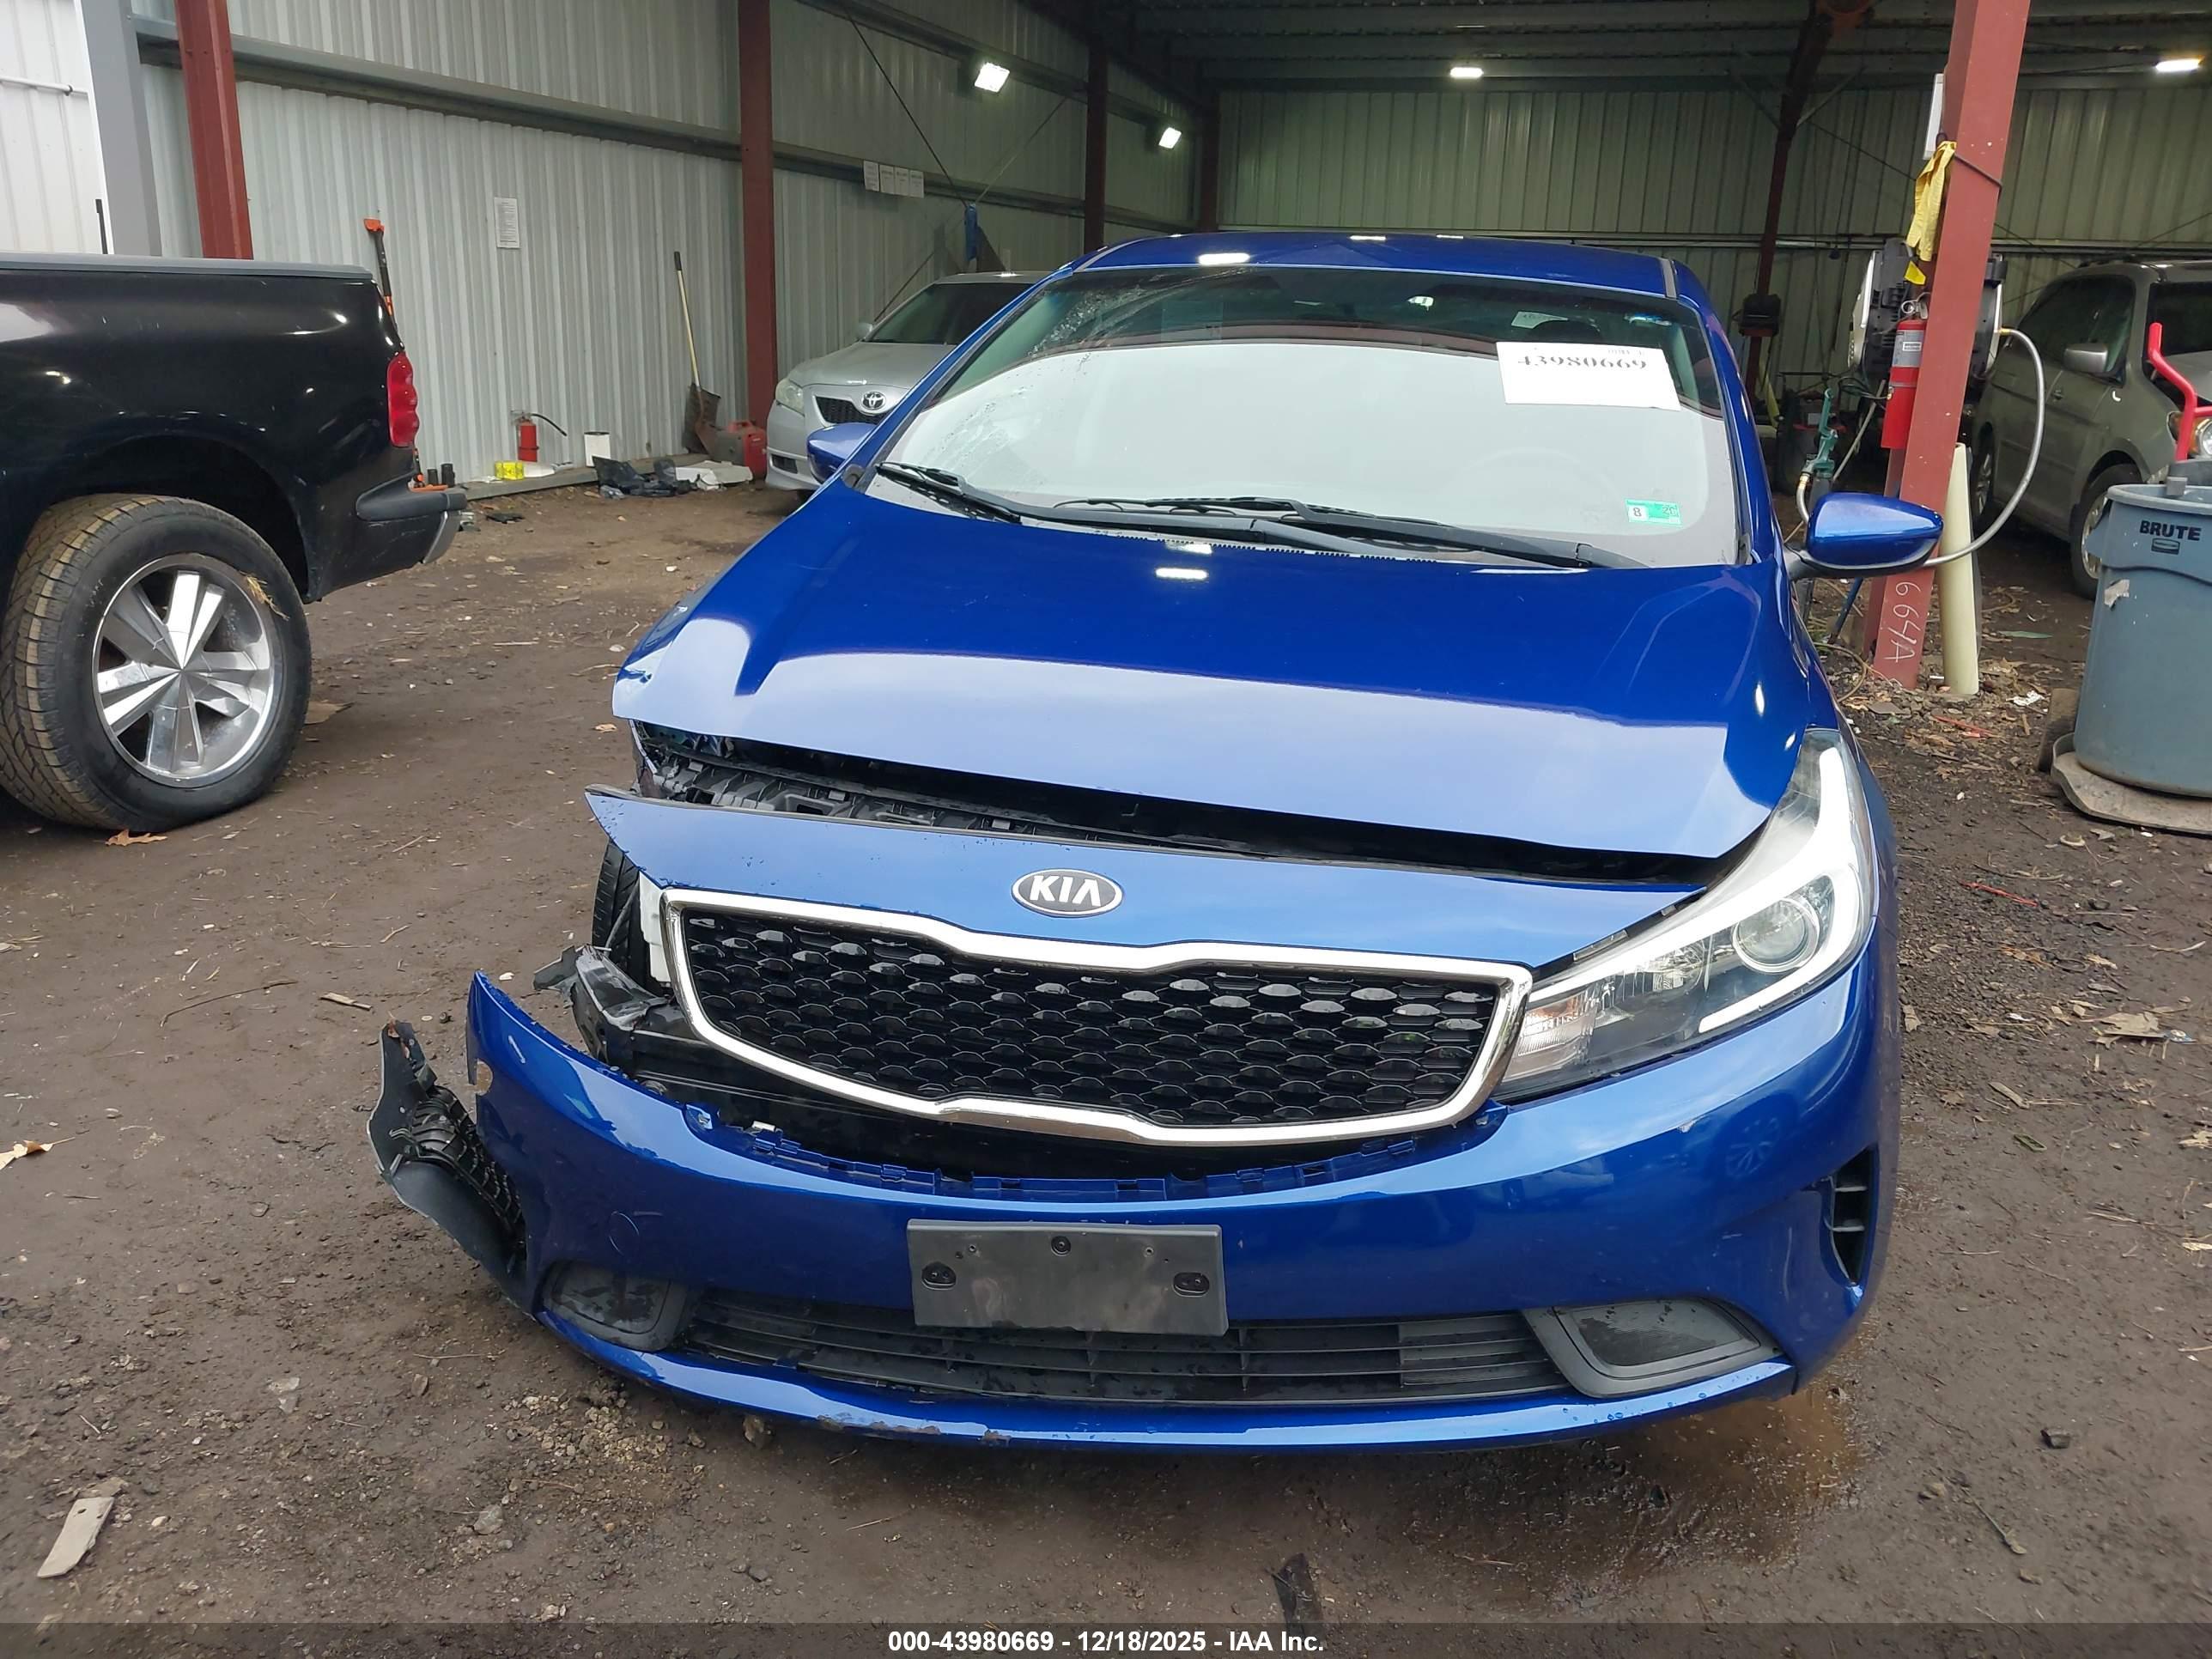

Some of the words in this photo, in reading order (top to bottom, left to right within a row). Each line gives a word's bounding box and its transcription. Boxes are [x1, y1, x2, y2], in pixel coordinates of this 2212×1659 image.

[1517, 355, 1647, 369] 43980669
[1632, 507, 1643, 517] 8
[2139, 520, 2203, 541] BRUTE
[1029, 874, 1102, 908] KIA
